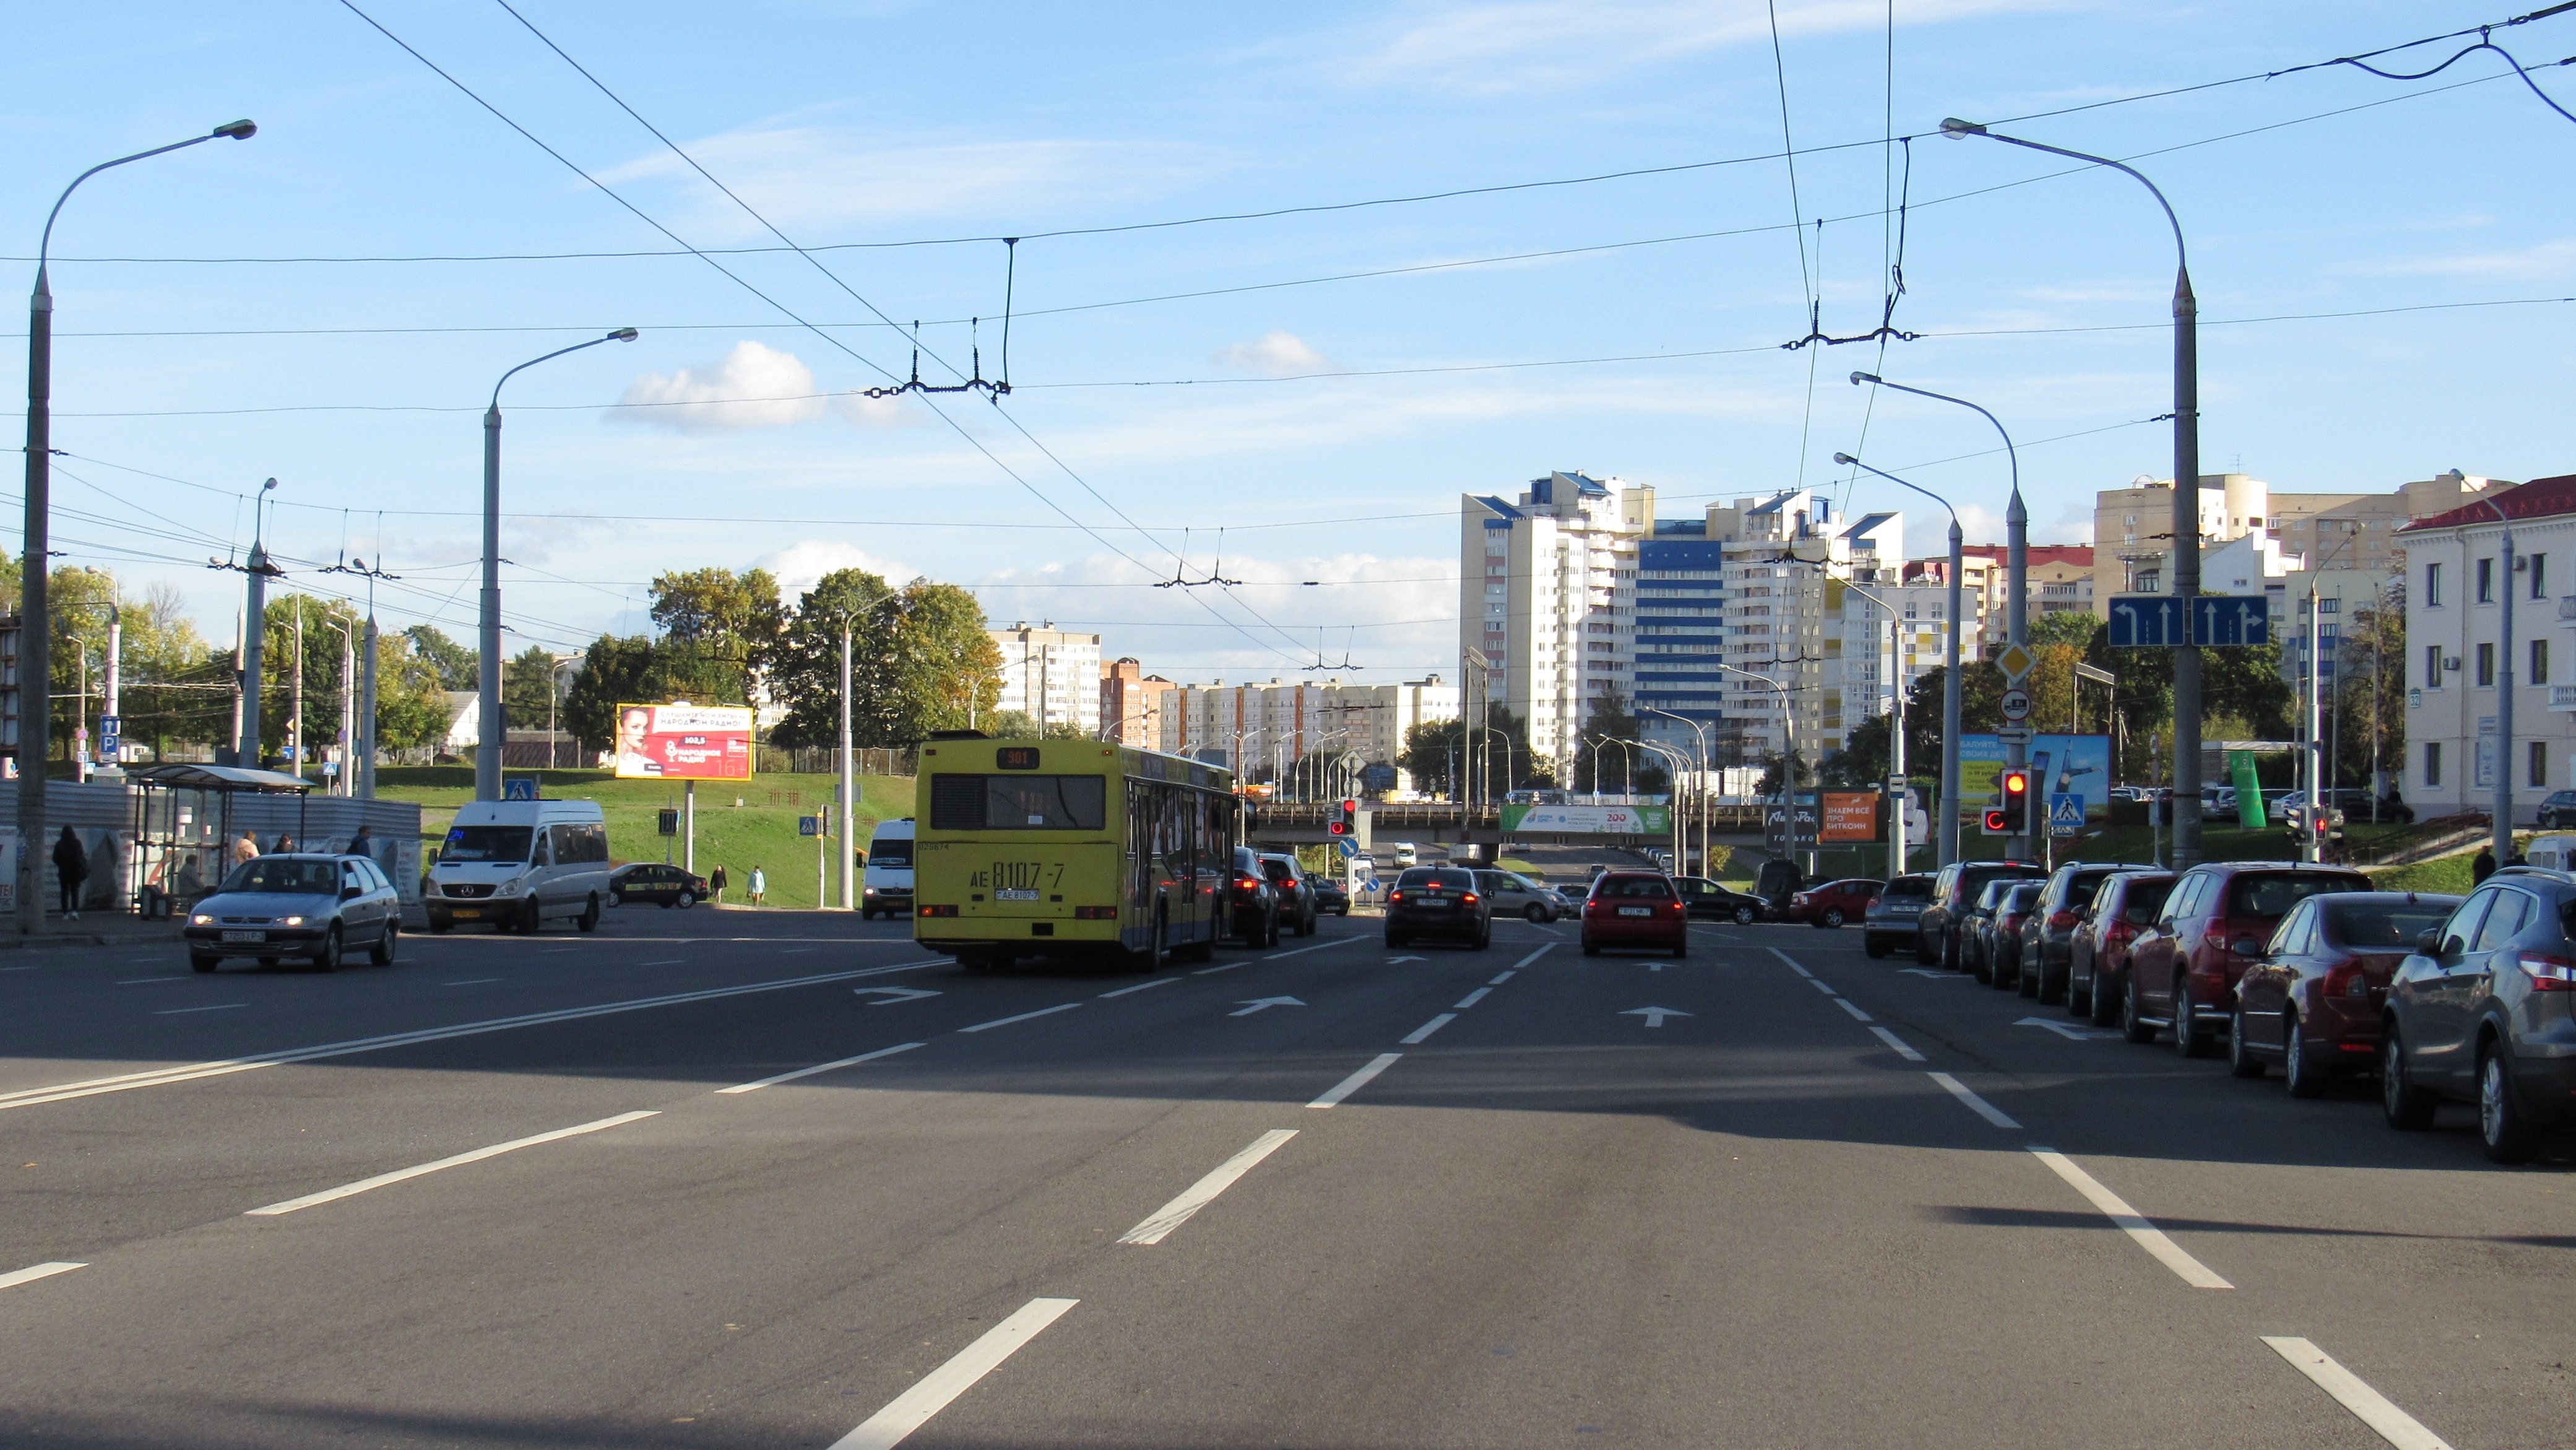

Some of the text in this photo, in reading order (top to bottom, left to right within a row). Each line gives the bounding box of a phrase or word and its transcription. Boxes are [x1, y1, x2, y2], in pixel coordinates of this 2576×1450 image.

[2410, 695, 2418, 706] 32
[105, 737, 115, 751] P
[685, 737, 706, 745] 102,5
[1960, 740, 1997, 748] БАЛУЙТЕ
[1008, 751, 1028, 764] 901
[715, 760, 746, 776] 16+
[1856, 806, 1869, 814] ВСЁ
[1607, 814, 1627, 822] 200
[970, 871, 988, 887] AE
